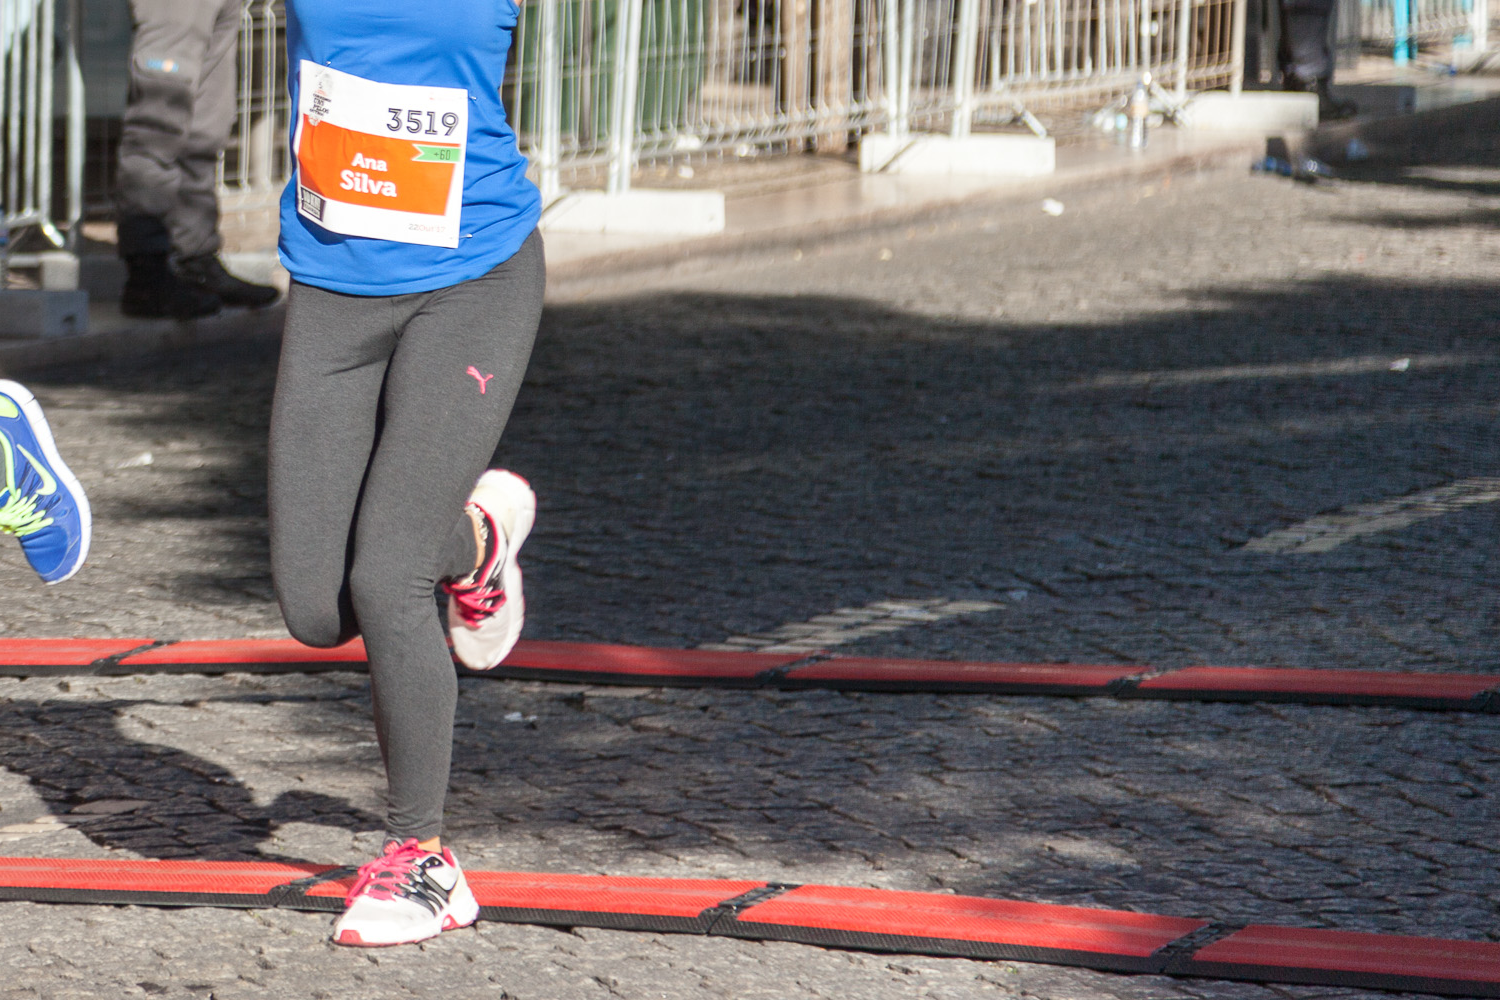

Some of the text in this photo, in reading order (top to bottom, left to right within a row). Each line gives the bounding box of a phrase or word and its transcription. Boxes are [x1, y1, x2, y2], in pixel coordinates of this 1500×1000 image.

[386, 107, 459, 136] 3519
[351, 152, 388, 172] Ana
[340, 169, 398, 198] Silva
